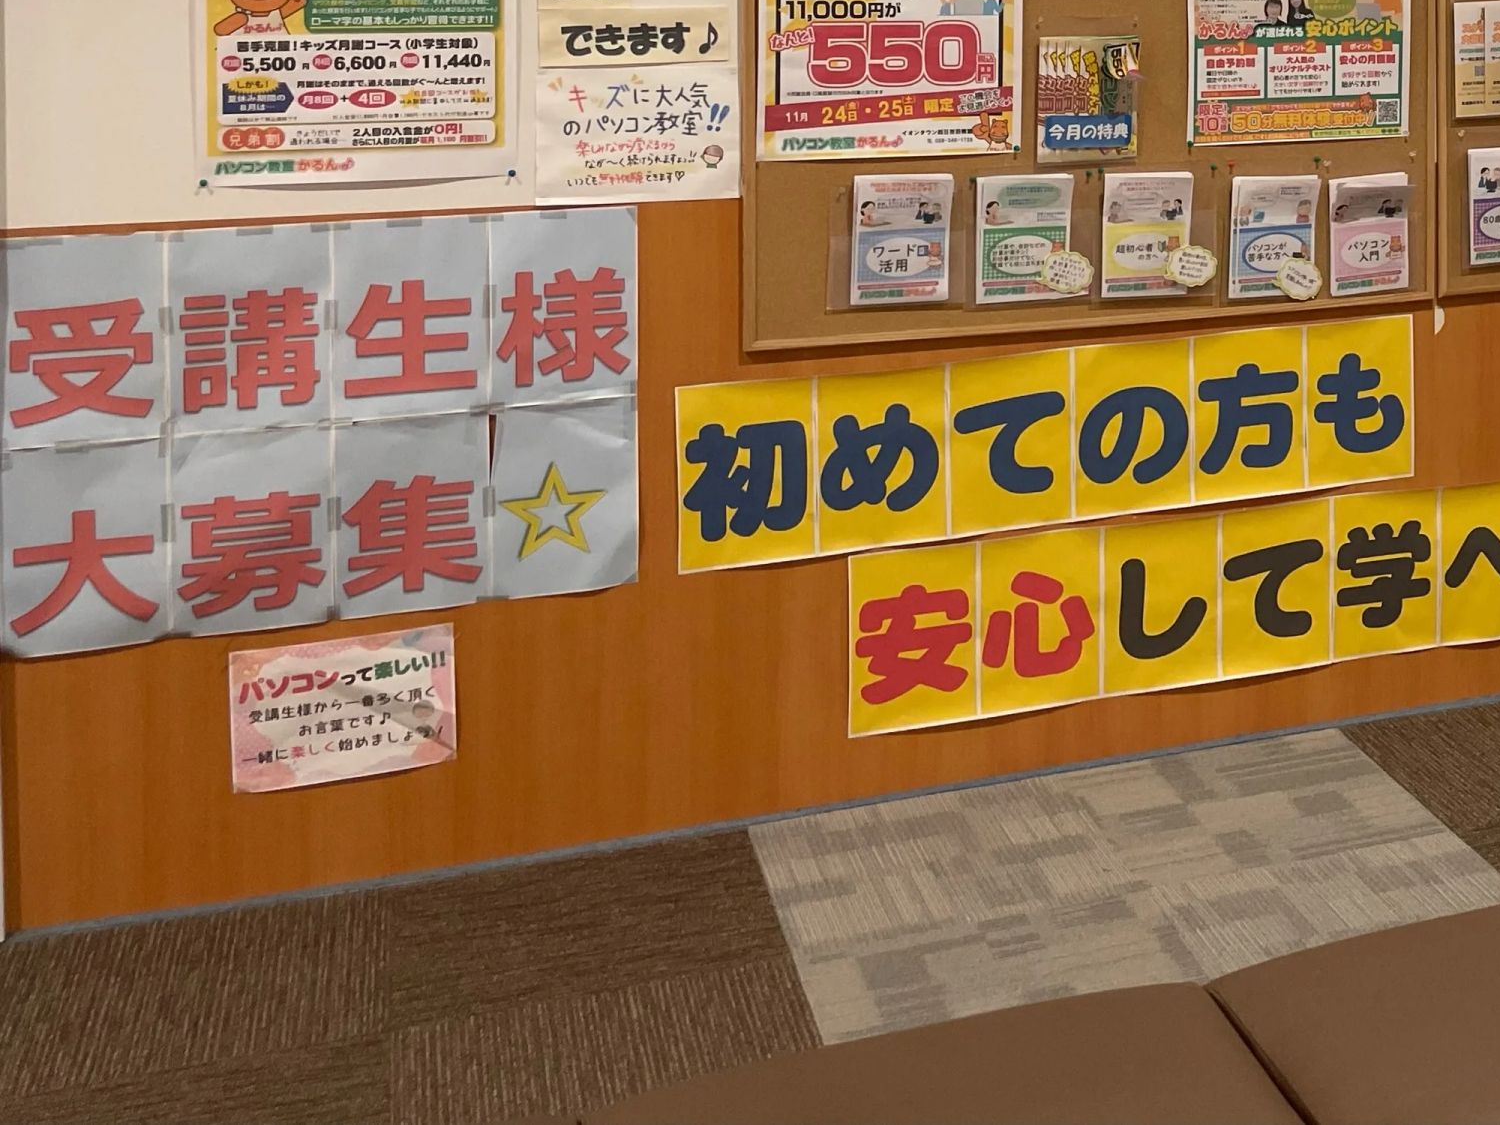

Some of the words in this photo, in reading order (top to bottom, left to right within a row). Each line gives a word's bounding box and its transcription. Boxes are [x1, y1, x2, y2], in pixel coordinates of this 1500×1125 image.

[785, 1, 901, 22] 11,000円が
[243, 24, 276, 33] かるん
[1199, 21, 1241, 40] かるん
[1256, 25, 1304, 38] が選ばれる
[1306, 19, 1398, 36] 安心ポイント
[561, 22, 690, 56] できます
[769, 27, 816, 51] なんと!
[1350, 39, 1383, 52] ポイント3
[1214, 42, 1245, 55] ポイント1
[1282, 40, 1316, 53] ポイント2
[808, 21, 981, 88] 550
[243, 58, 296, 73] 5,500
[302, 62, 310, 70] 円
[334, 56, 386, 70] 6,600
[422, 54, 482, 69] 11,440
[1269, 64, 1332, 73] オリジナルテキスト
[976, 64, 994, 83] 円
[236, 81, 270, 89] しかも!
[302, 94, 334, 106] 月8回
[360, 92, 386, 105] 4回
[785, 112, 808, 123] 11月
[924, 98, 954, 112] 限定
[564, 103, 730, 136] のパソコン教室!!
[1048, 123, 1128, 141] 今月の特典
[229, 134, 281, 148] 兄弟割
[782, 137, 856, 151] パソコン教室
[857, 137, 890, 148] かるん
[297, 159, 338, 171] かるん
[873, 244, 917, 257] ワード
[1116, 244, 1153, 255] 超初心者
[1249, 243, 1287, 252] パソコンが
[1348, 239, 1390, 251] パソコン
[1138, 252, 1159, 261] の方へ
[1247, 251, 1290, 262] 苦手な方へ
[1359, 251, 1379, 262] 入門
[879, 258, 908, 272] 活用
[8, 266, 633, 428] 受講生様
[684, 351, 1404, 543] 初めての方も
[10, 474, 487, 638] 大募集
[239, 651, 446, 704] パソコンって楽しい!!
[249, 686, 436, 724] 受講生様から一番多く頂く
[299, 715, 375, 736] お言葉です
